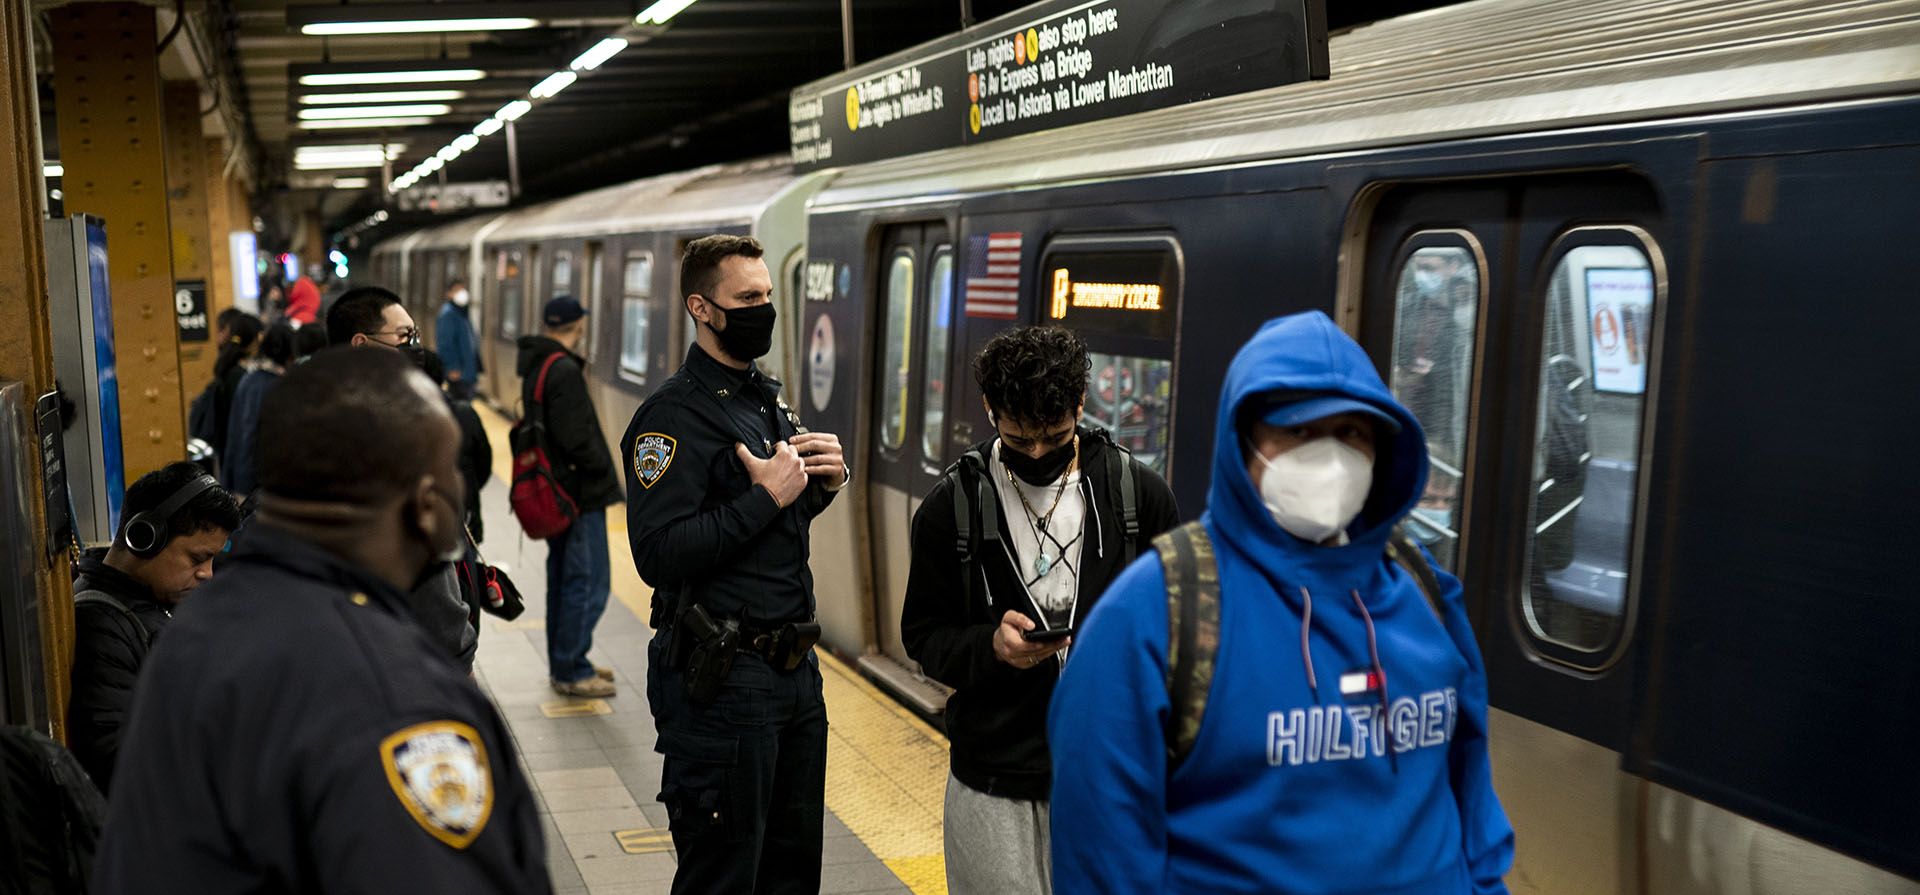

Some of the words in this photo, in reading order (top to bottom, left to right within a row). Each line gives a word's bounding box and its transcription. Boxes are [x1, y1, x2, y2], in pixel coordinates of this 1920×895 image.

[967, 48, 987, 73] Late
[987, 38, 1014, 69] nights
[1038, 23, 1060, 51] also
[1062, 17, 1086, 45] stop
[1088, 8, 1118, 36] here:
[978, 74, 987, 98] 6
[988, 72, 999, 96] Av
[1001, 65, 1038, 94] Express
[1040, 56, 1056, 82] via
[1057, 48, 1092, 79] Bridge
[980, 96, 1004, 126] Local
[1005, 96, 1016, 121] to
[1018, 88, 1052, 119] Astoria
[1054, 84, 1070, 109] via
[1071, 79, 1105, 107] Lower
[1108, 62, 1173, 100] Manhattan
[892, 98, 902, 120] to
[933, 84, 944, 110] St
[1051, 268, 1069, 319] R
[1125, 284, 1161, 310] LOCAL
[637, 441, 671, 453] DEPARTMENT
[644, 436, 664, 444] POLICE
